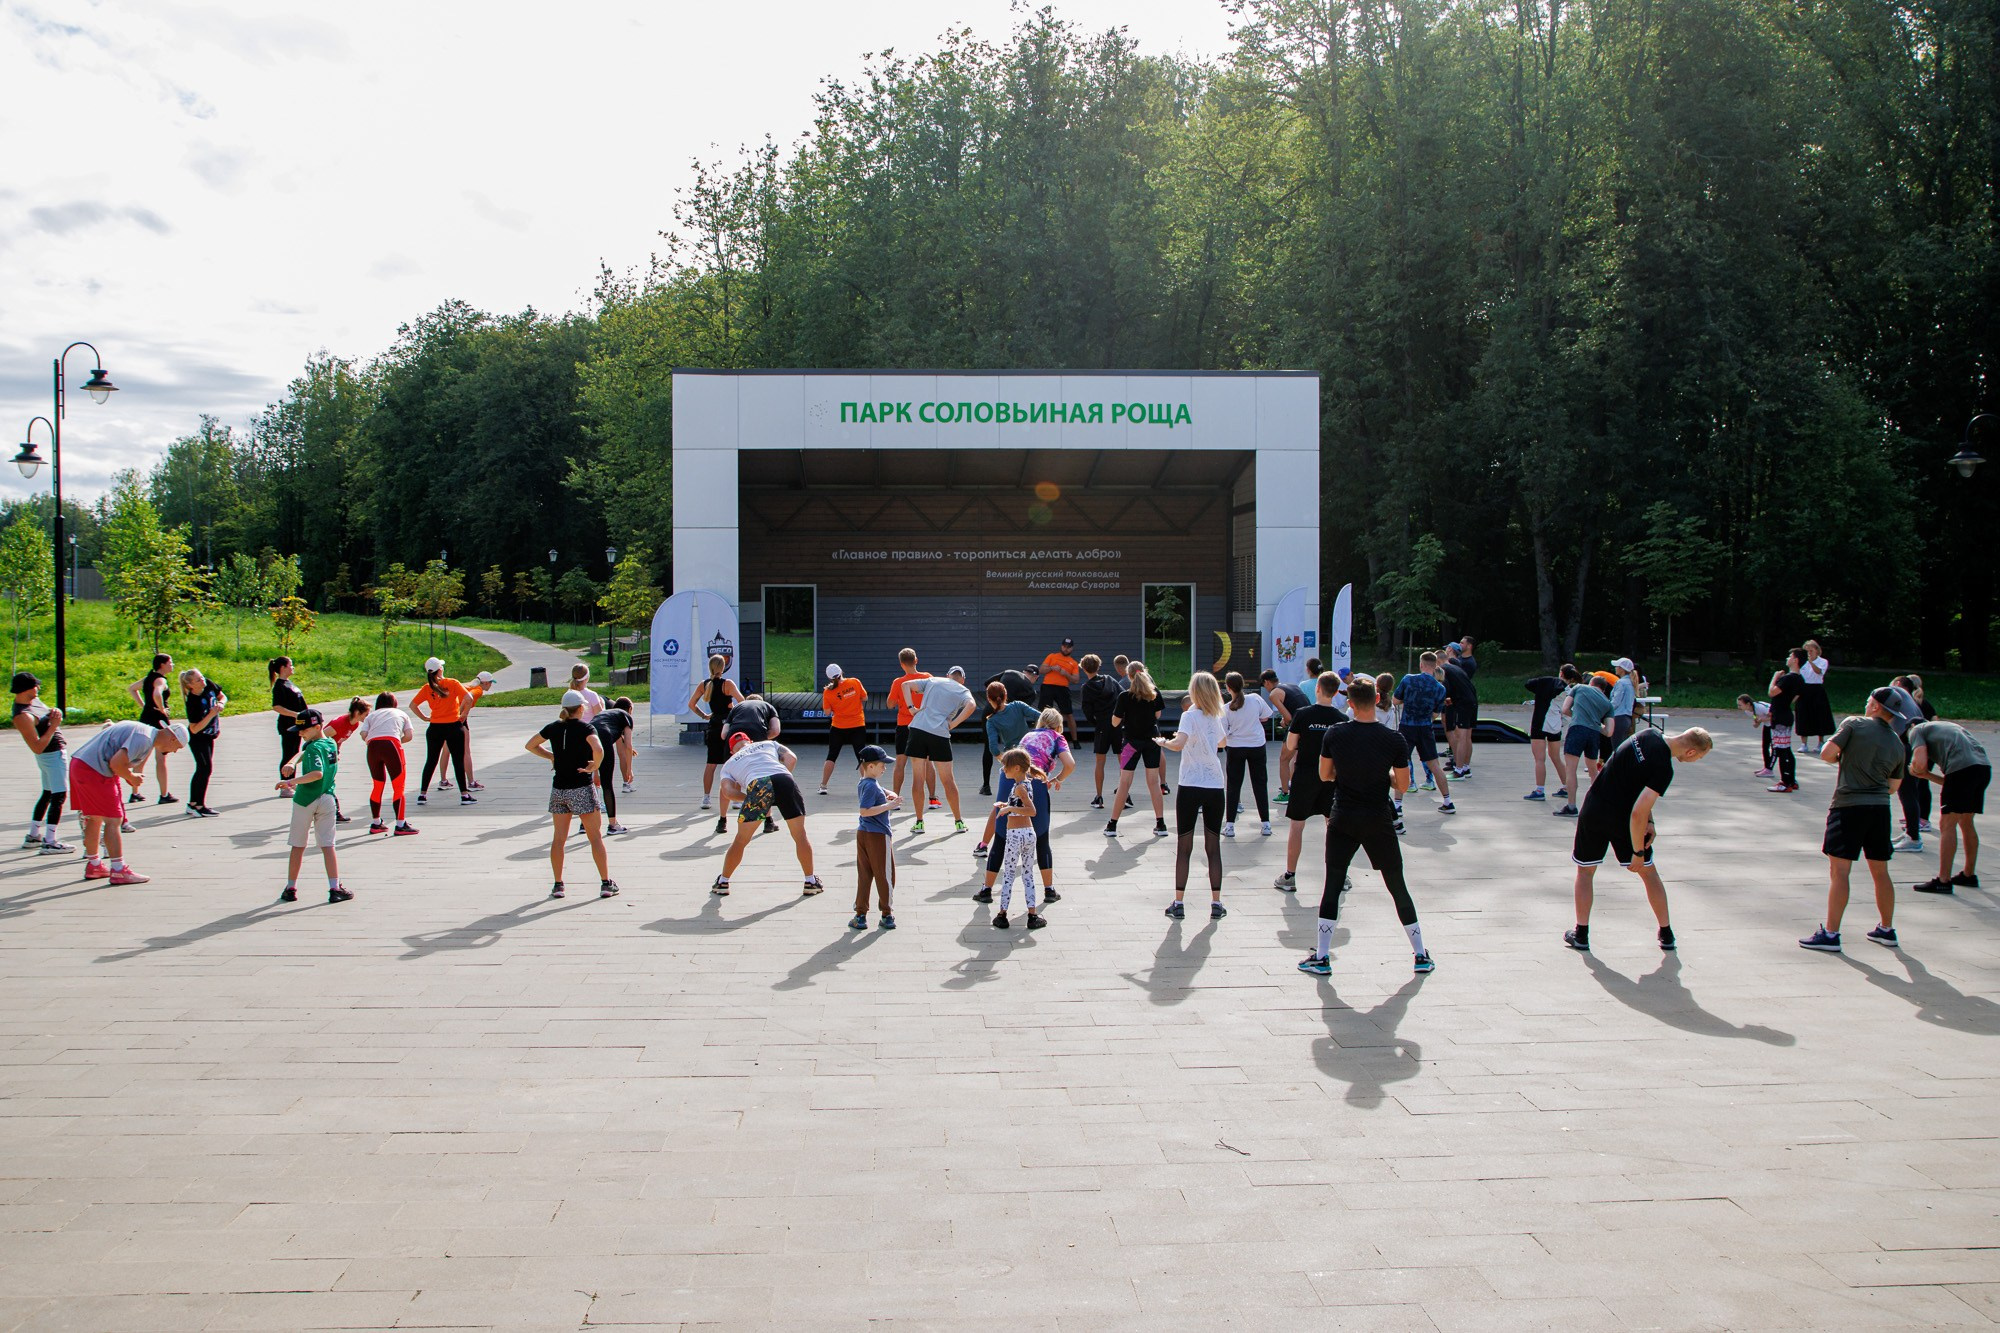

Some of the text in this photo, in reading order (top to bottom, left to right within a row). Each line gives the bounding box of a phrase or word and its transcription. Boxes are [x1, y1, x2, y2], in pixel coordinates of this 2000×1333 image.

[840, 402, 1192, 428] ПАРК СОЛОВЬИНАЯ РОЩА
[831, 549, 888, 559] «Главное
[891, 550, 943, 561] правило
[953, 550, 1026, 562] торопиться
[1029, 549, 1073, 560] делать
[1075, 549, 1121, 561] добро»
[986, 569, 1120, 580] Великий русский полководец
[1028, 581, 1120, 590] Александр Суворов
